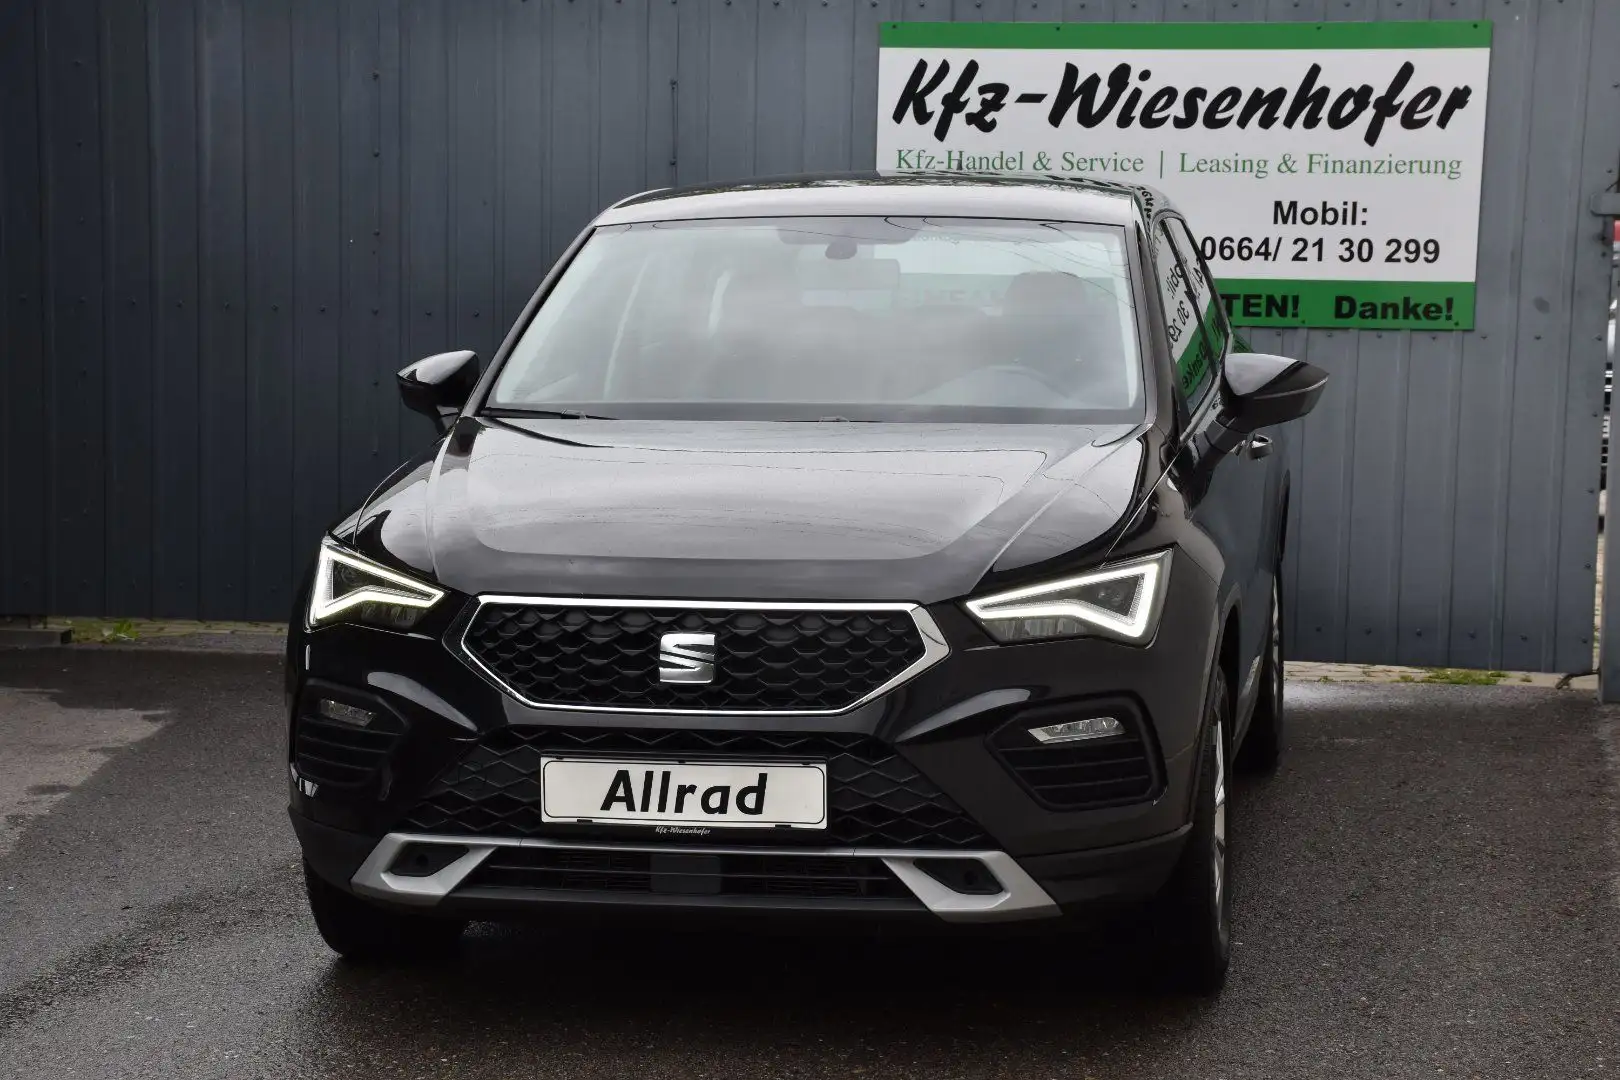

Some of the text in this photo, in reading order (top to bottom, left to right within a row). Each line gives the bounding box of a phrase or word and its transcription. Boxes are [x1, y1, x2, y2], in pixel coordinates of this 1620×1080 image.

[892, 58, 1472, 147] Kfz-Wiesenhofer
[896, 149, 1024, 172] Kfz-Handel
[1032, 152, 1053, 172] &
[1061, 152, 1144, 173] Service
[1179, 152, 1269, 179] Leasing
[1277, 153, 1298, 174] &
[1307, 153, 1463, 180] Finanzierung
[1273, 200, 1368, 226] Mobil:
[1201, 236, 1440, 264] 0664/ 21 30 299
[1334, 295, 1455, 322] Danke!
[600, 769, 768, 816] Allrad
